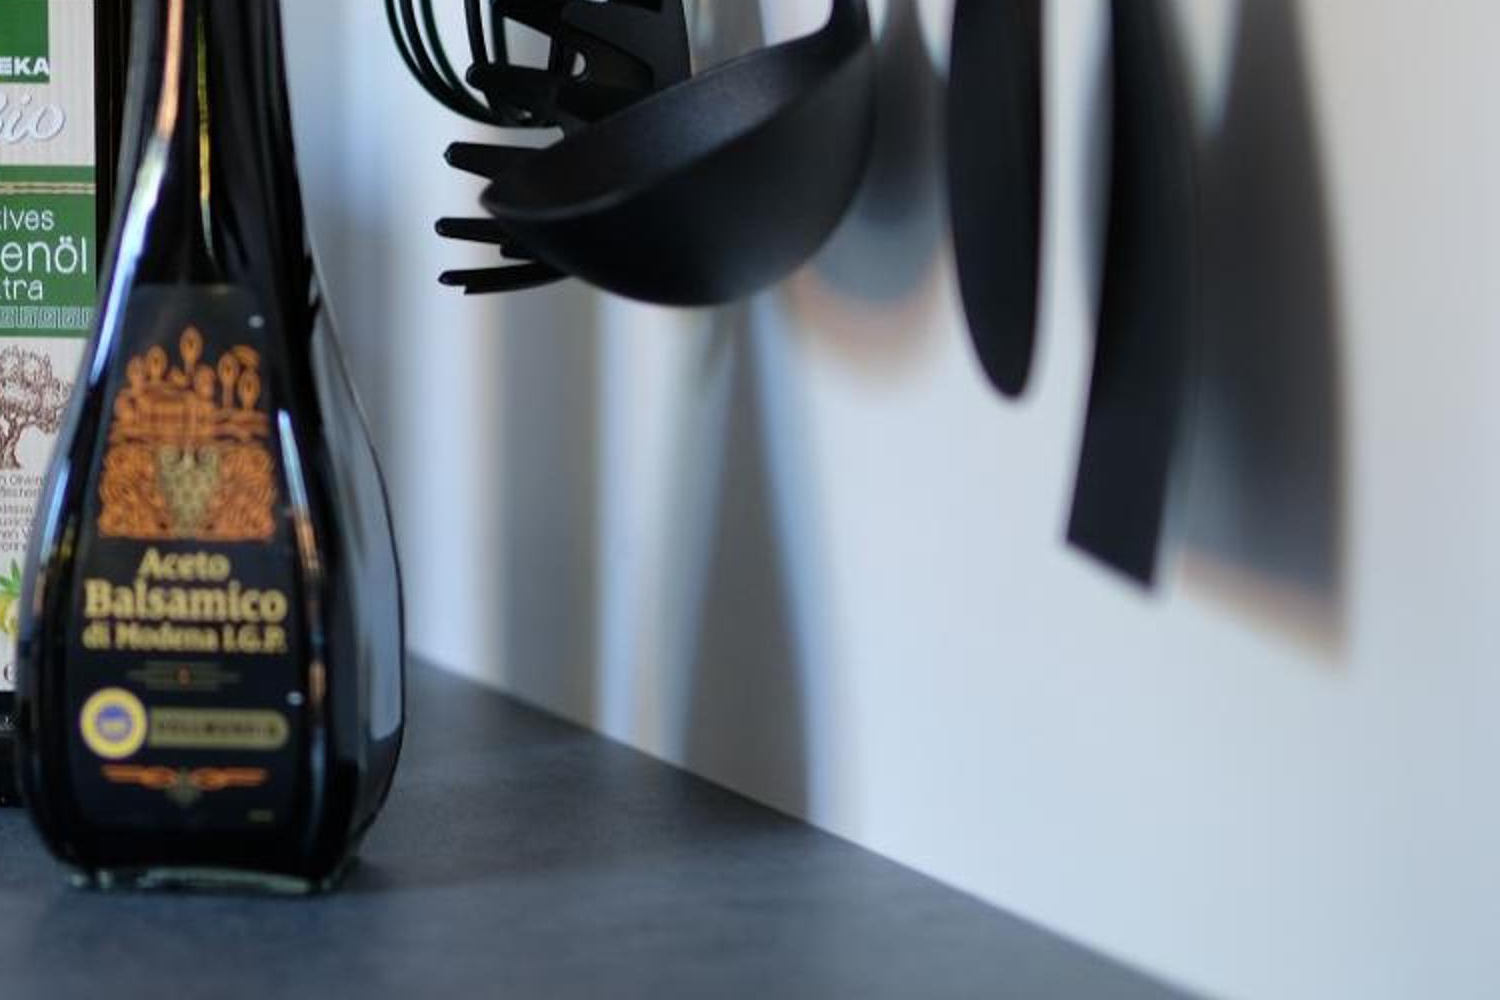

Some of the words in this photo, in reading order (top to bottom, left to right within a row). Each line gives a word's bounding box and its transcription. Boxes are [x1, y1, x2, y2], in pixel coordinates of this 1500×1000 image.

[138, 547, 231, 581] Aceto
[83, 577, 288, 623] Balsamico
[82, 622, 110, 649] di
[115, 622, 219, 651] Modena
